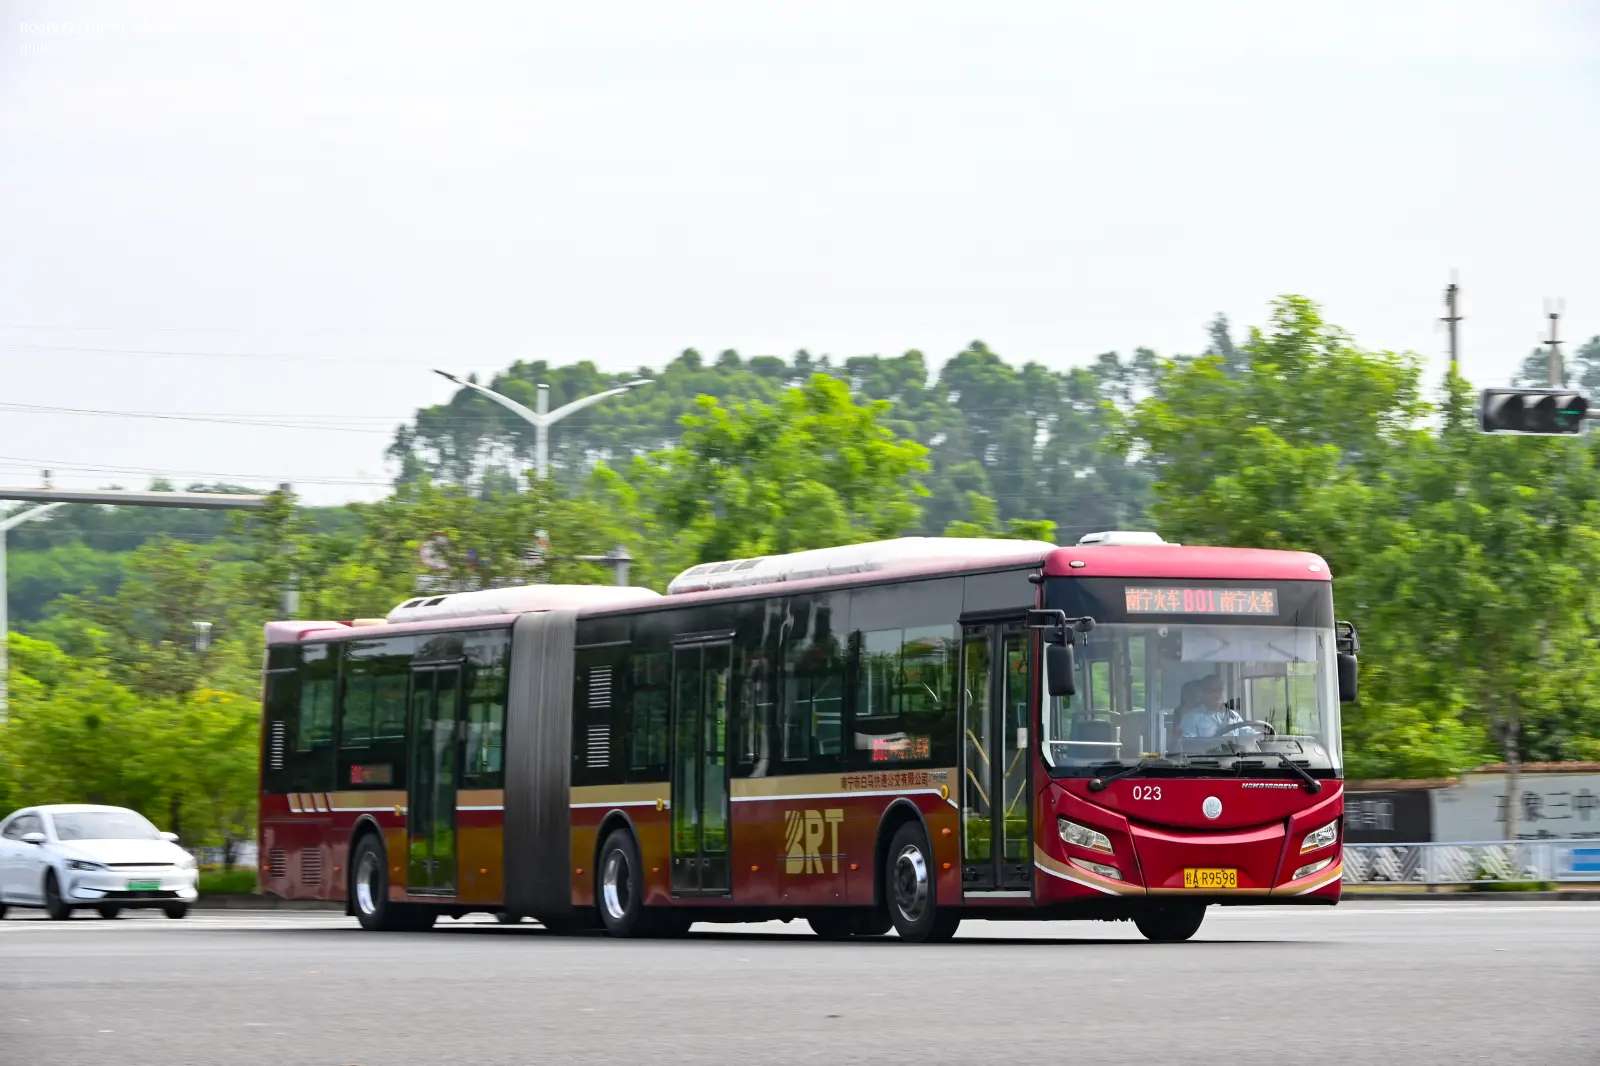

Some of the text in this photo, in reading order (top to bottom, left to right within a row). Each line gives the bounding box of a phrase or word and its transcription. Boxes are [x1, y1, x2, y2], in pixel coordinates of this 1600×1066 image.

[1126, 588, 1180, 611] 南宁火车
[1184, 589, 1215, 612] B01
[1133, 785, 1162, 801] 023
[784, 808, 844, 874] BRT
